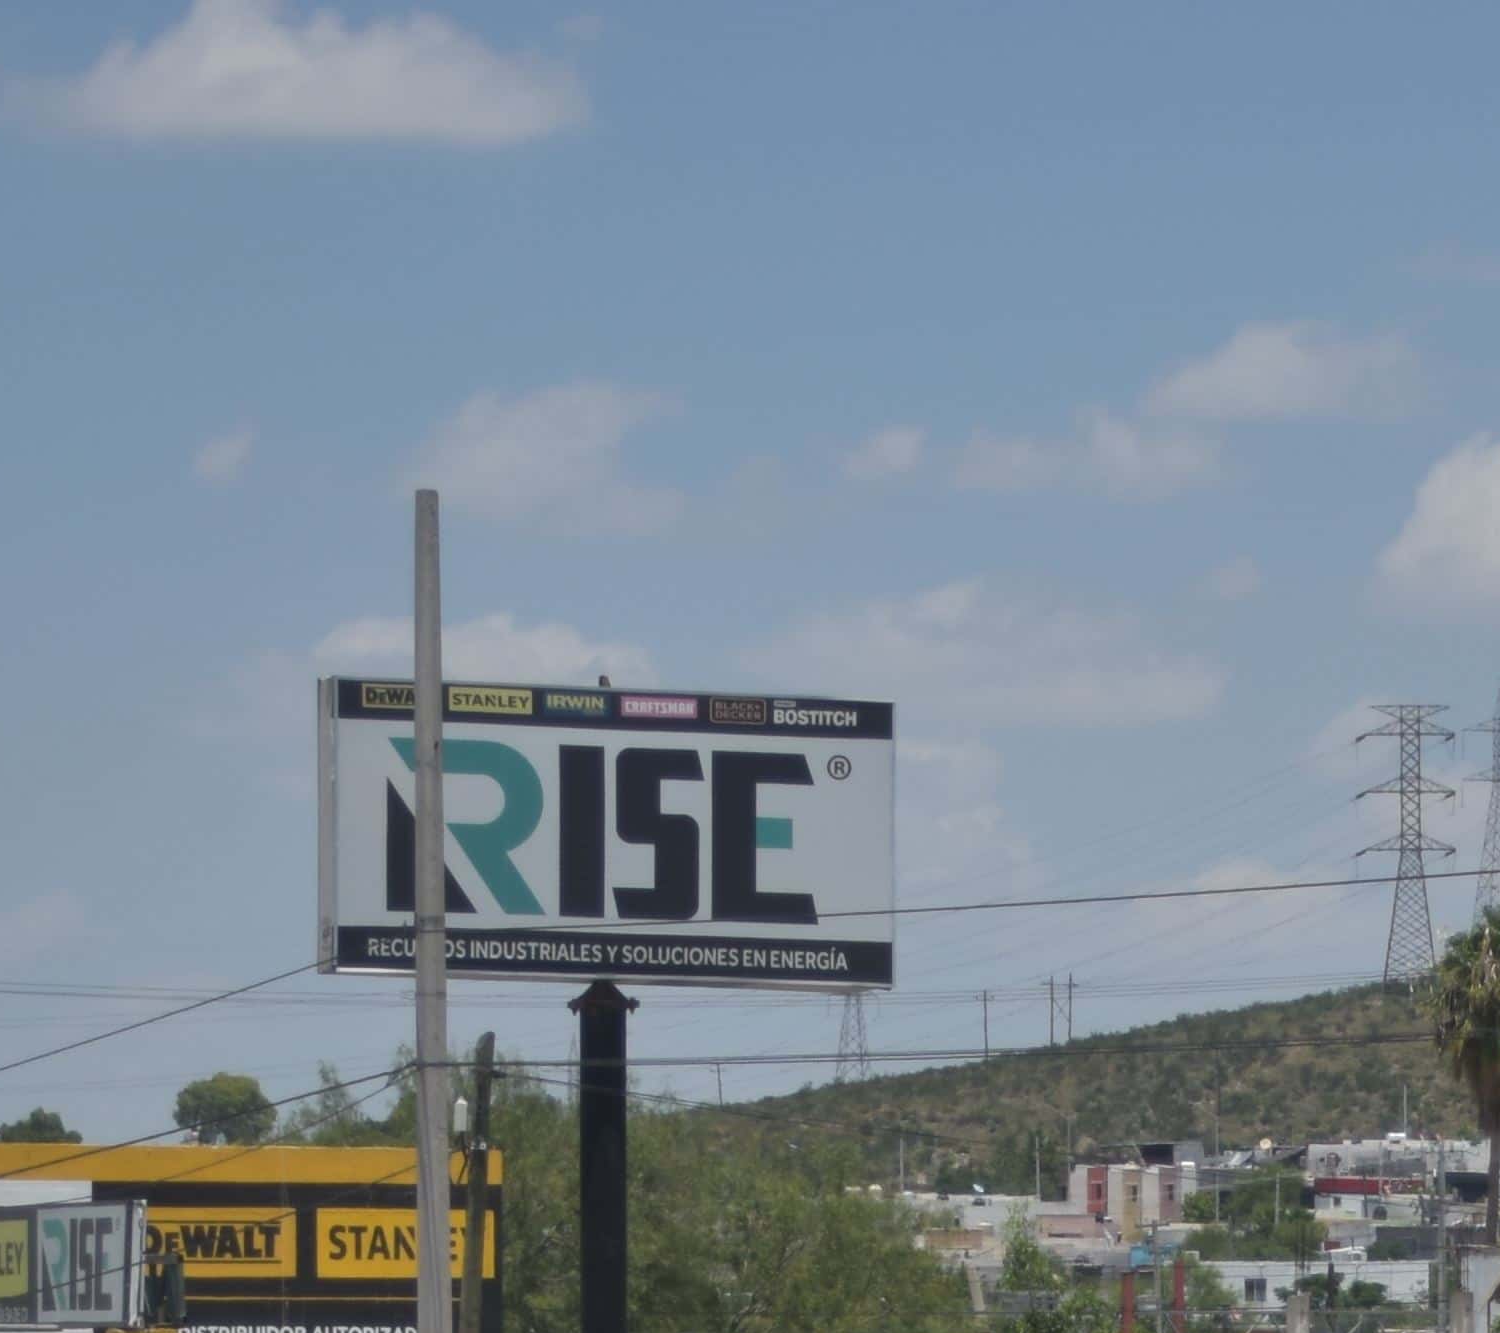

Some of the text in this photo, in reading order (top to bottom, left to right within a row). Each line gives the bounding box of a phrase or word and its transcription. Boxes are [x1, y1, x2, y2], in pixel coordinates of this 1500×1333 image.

[452, 692, 530, 709] STANLEY
[546, 694, 605, 709] IRWIN
[624, 699, 694, 715] CRAFTSMAN
[714, 711, 762, 722] DECKER
[773, 710, 858, 727] BOSTITCH
[386, 737, 819, 925] RISE
[368, 938, 848, 970] RECUOS INDUSTRIALES Y SOLUCIONES EN ENERGÍA
[41, 1217, 113, 1312] RISE
